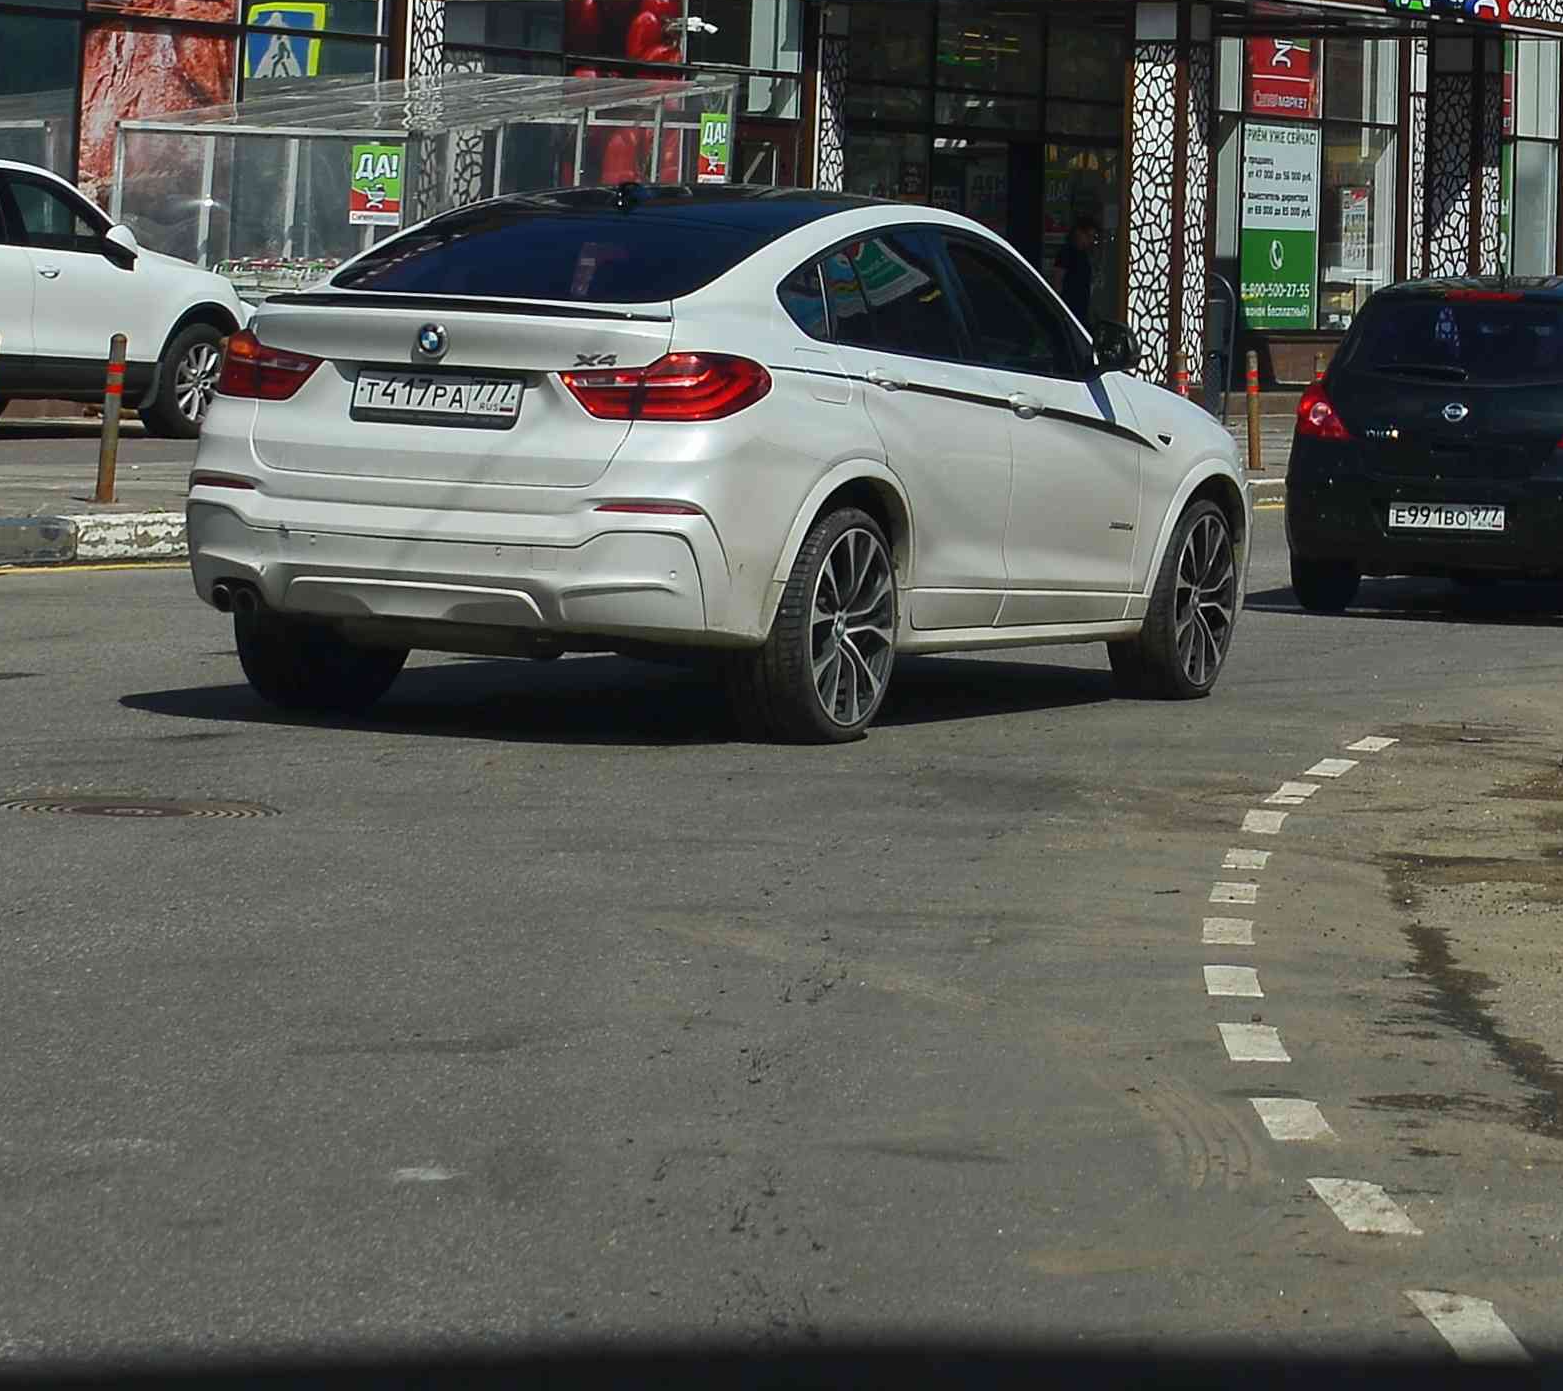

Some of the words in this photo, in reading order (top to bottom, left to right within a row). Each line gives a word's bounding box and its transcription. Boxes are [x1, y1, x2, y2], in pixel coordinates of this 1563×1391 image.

[701, 121, 727, 146] ДА!
[355, 152, 400, 181] ДА!
[573, 353, 617, 367] X4
[472, 378, 511, 403] 777
